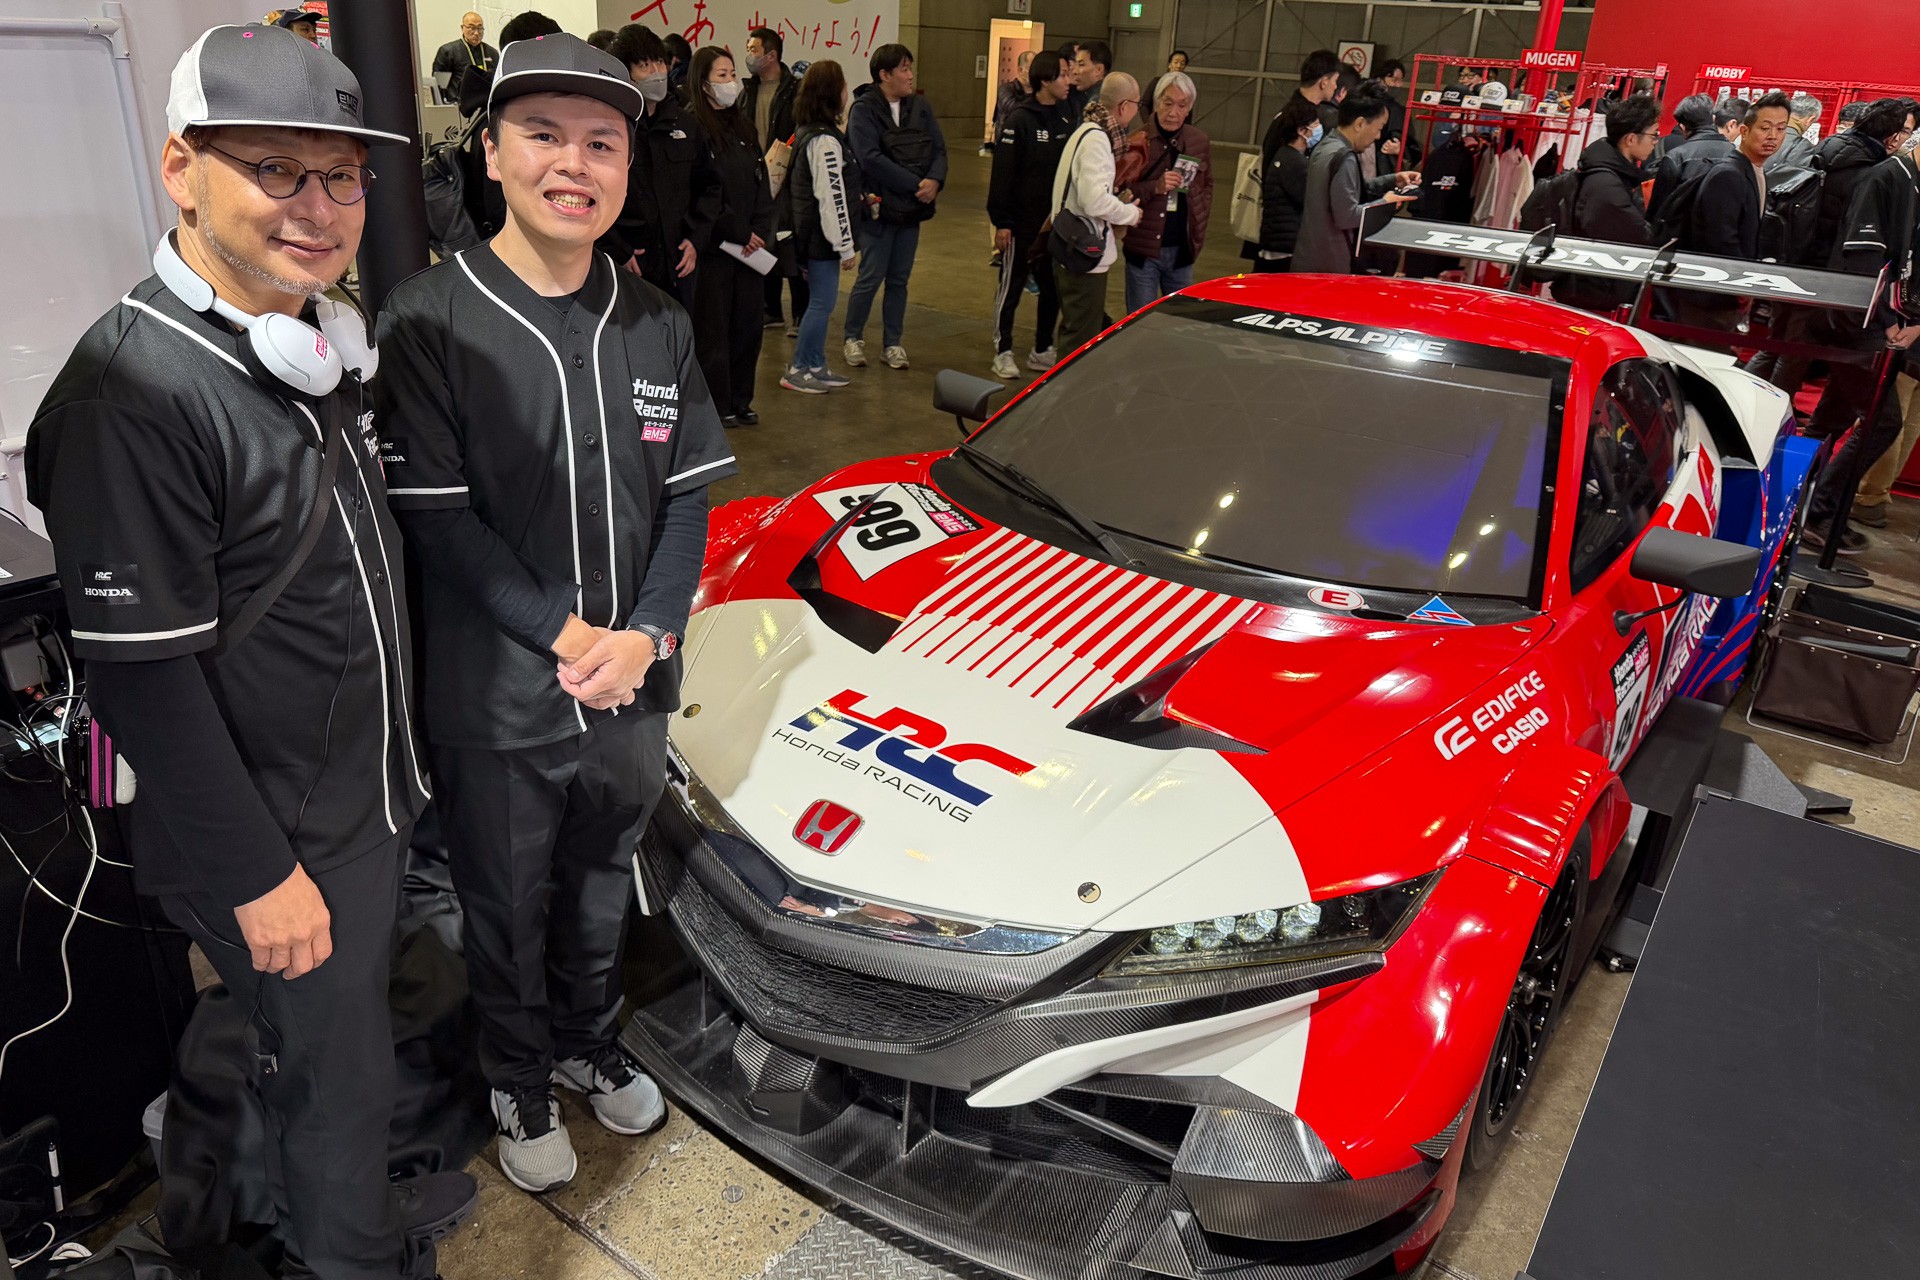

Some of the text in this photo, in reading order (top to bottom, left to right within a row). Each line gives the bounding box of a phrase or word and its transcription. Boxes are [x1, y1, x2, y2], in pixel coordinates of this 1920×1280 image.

[1525, 52, 1577, 67] MUGEN
[1705, 66, 1746, 79] HOBBY
[1415, 230, 1817, 296] HONDA
[177, 278, 201, 299] SONY
[643, 429, 668, 440] eMS
[839, 494, 921, 551] 99
[84, 587, 134, 597] HONDA
[1472, 670, 1545, 733] EDIFICE
[788, 688, 1038, 807] HRC
[1491, 707, 1550, 754] CASIO
[771, 728, 973, 824] Honda RACING
